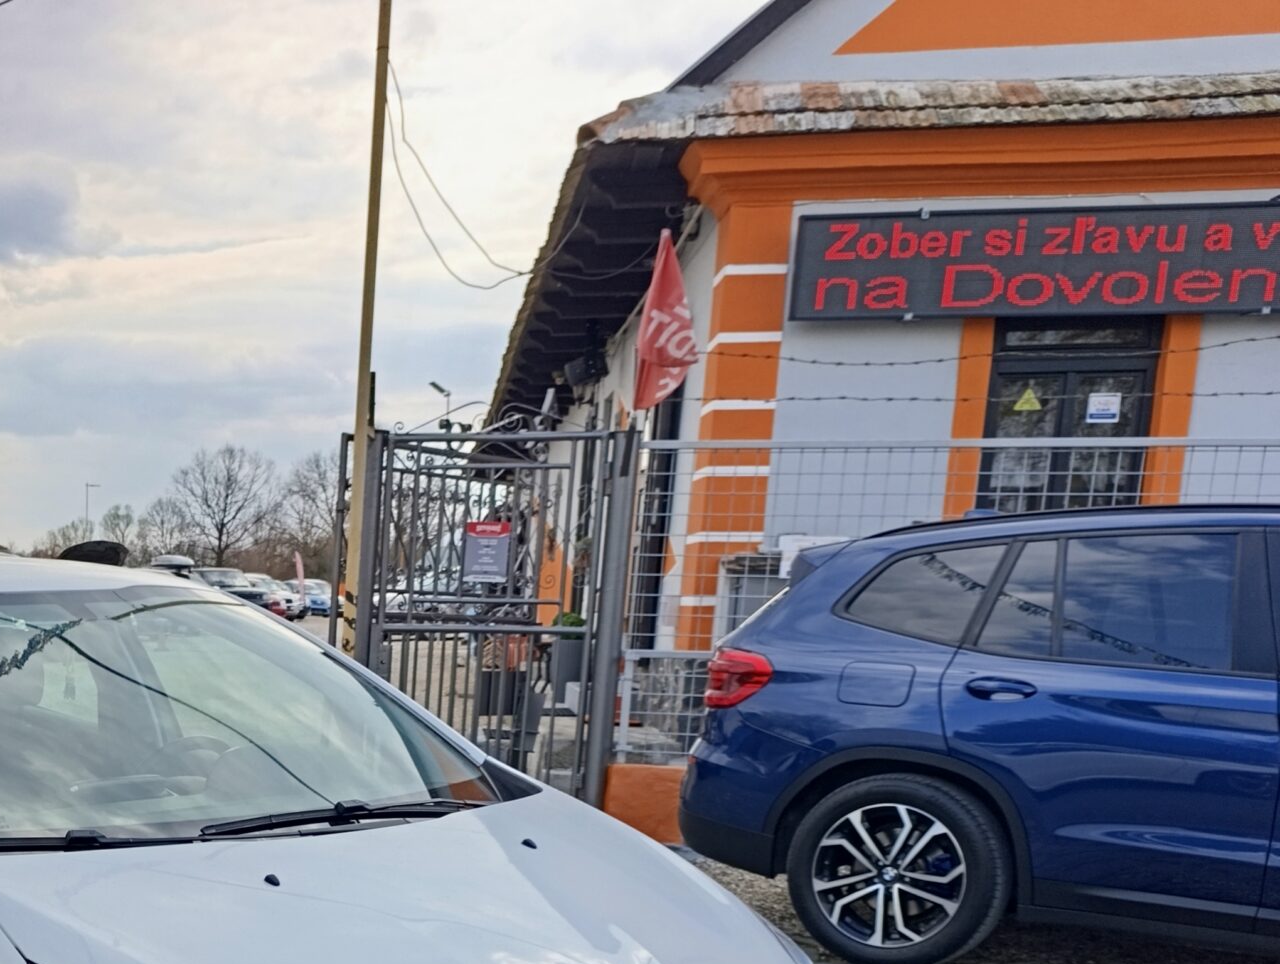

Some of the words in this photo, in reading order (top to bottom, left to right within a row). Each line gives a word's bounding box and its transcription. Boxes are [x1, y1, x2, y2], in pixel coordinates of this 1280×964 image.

[824, 221, 973, 261] Zober
[984, 217, 1029, 256] si
[1041, 215, 1188, 254] zľavu
[1203, 223, 1234, 252] a
[1253, 222, 1280, 250] v
[814, 275, 908, 311] na
[940, 259, 1278, 308] Dovolen
